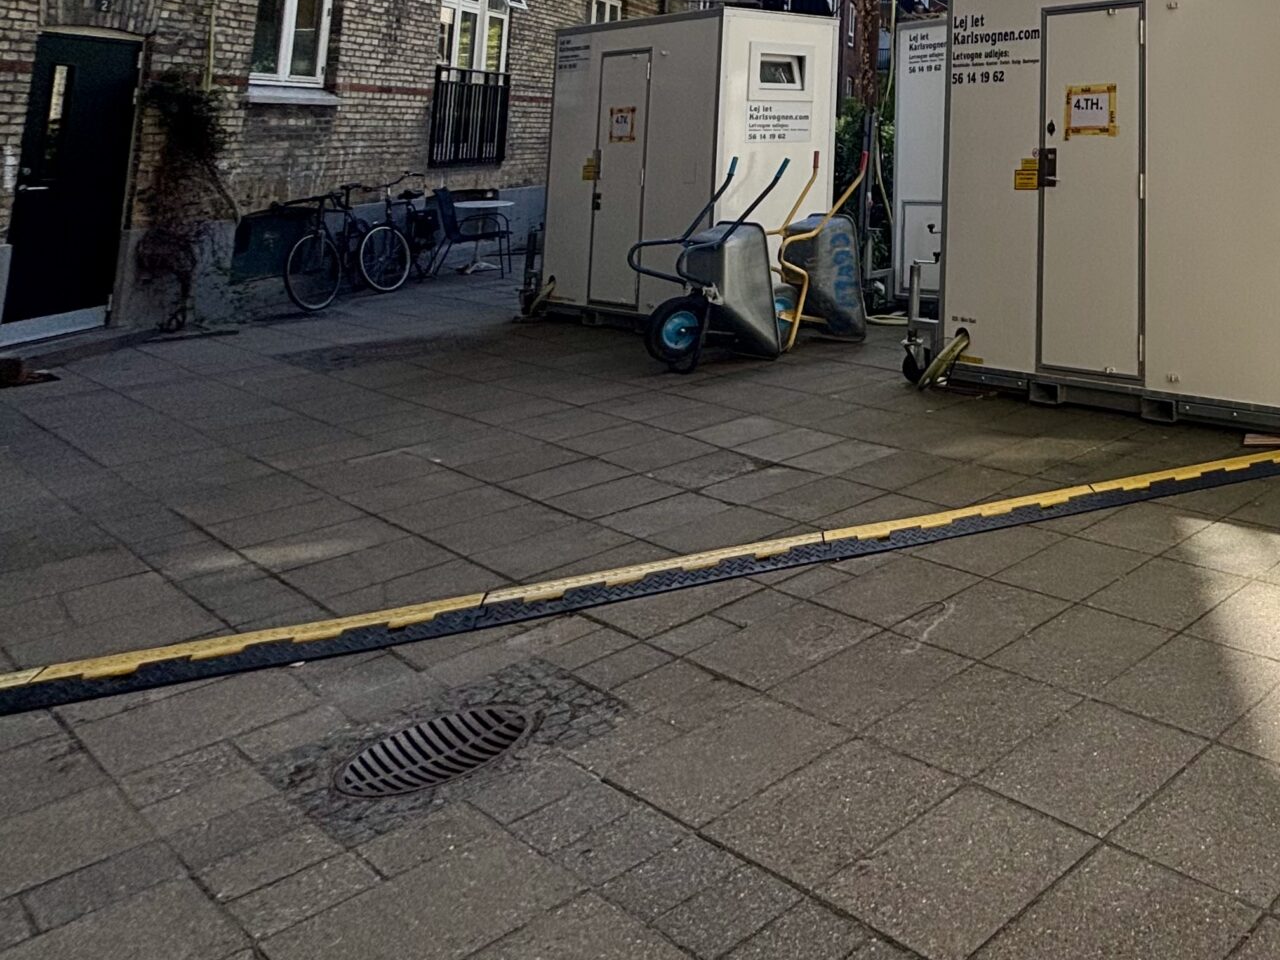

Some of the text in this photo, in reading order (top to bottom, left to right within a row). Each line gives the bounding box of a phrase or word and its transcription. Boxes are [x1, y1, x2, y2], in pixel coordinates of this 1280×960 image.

[101, 0, 108, 11] 2
[953, 14, 985, 31] Lej let
[909, 33, 929, 43] Lej let
[953, 28, 1041, 46] Karlsvognen.com
[952, 51, 983, 61] Letvogne
[984, 49, 1010, 60] udlejes:
[908, 66, 916, 74] 56
[934, 64, 942, 72] 62
[952, 70, 1005, 85] 56 14 19 62
[749, 105, 760, 113] Lej
[1073, 97, 1103, 110] 4.TH.
[749, 113, 809, 121] Karlsvognen.com
